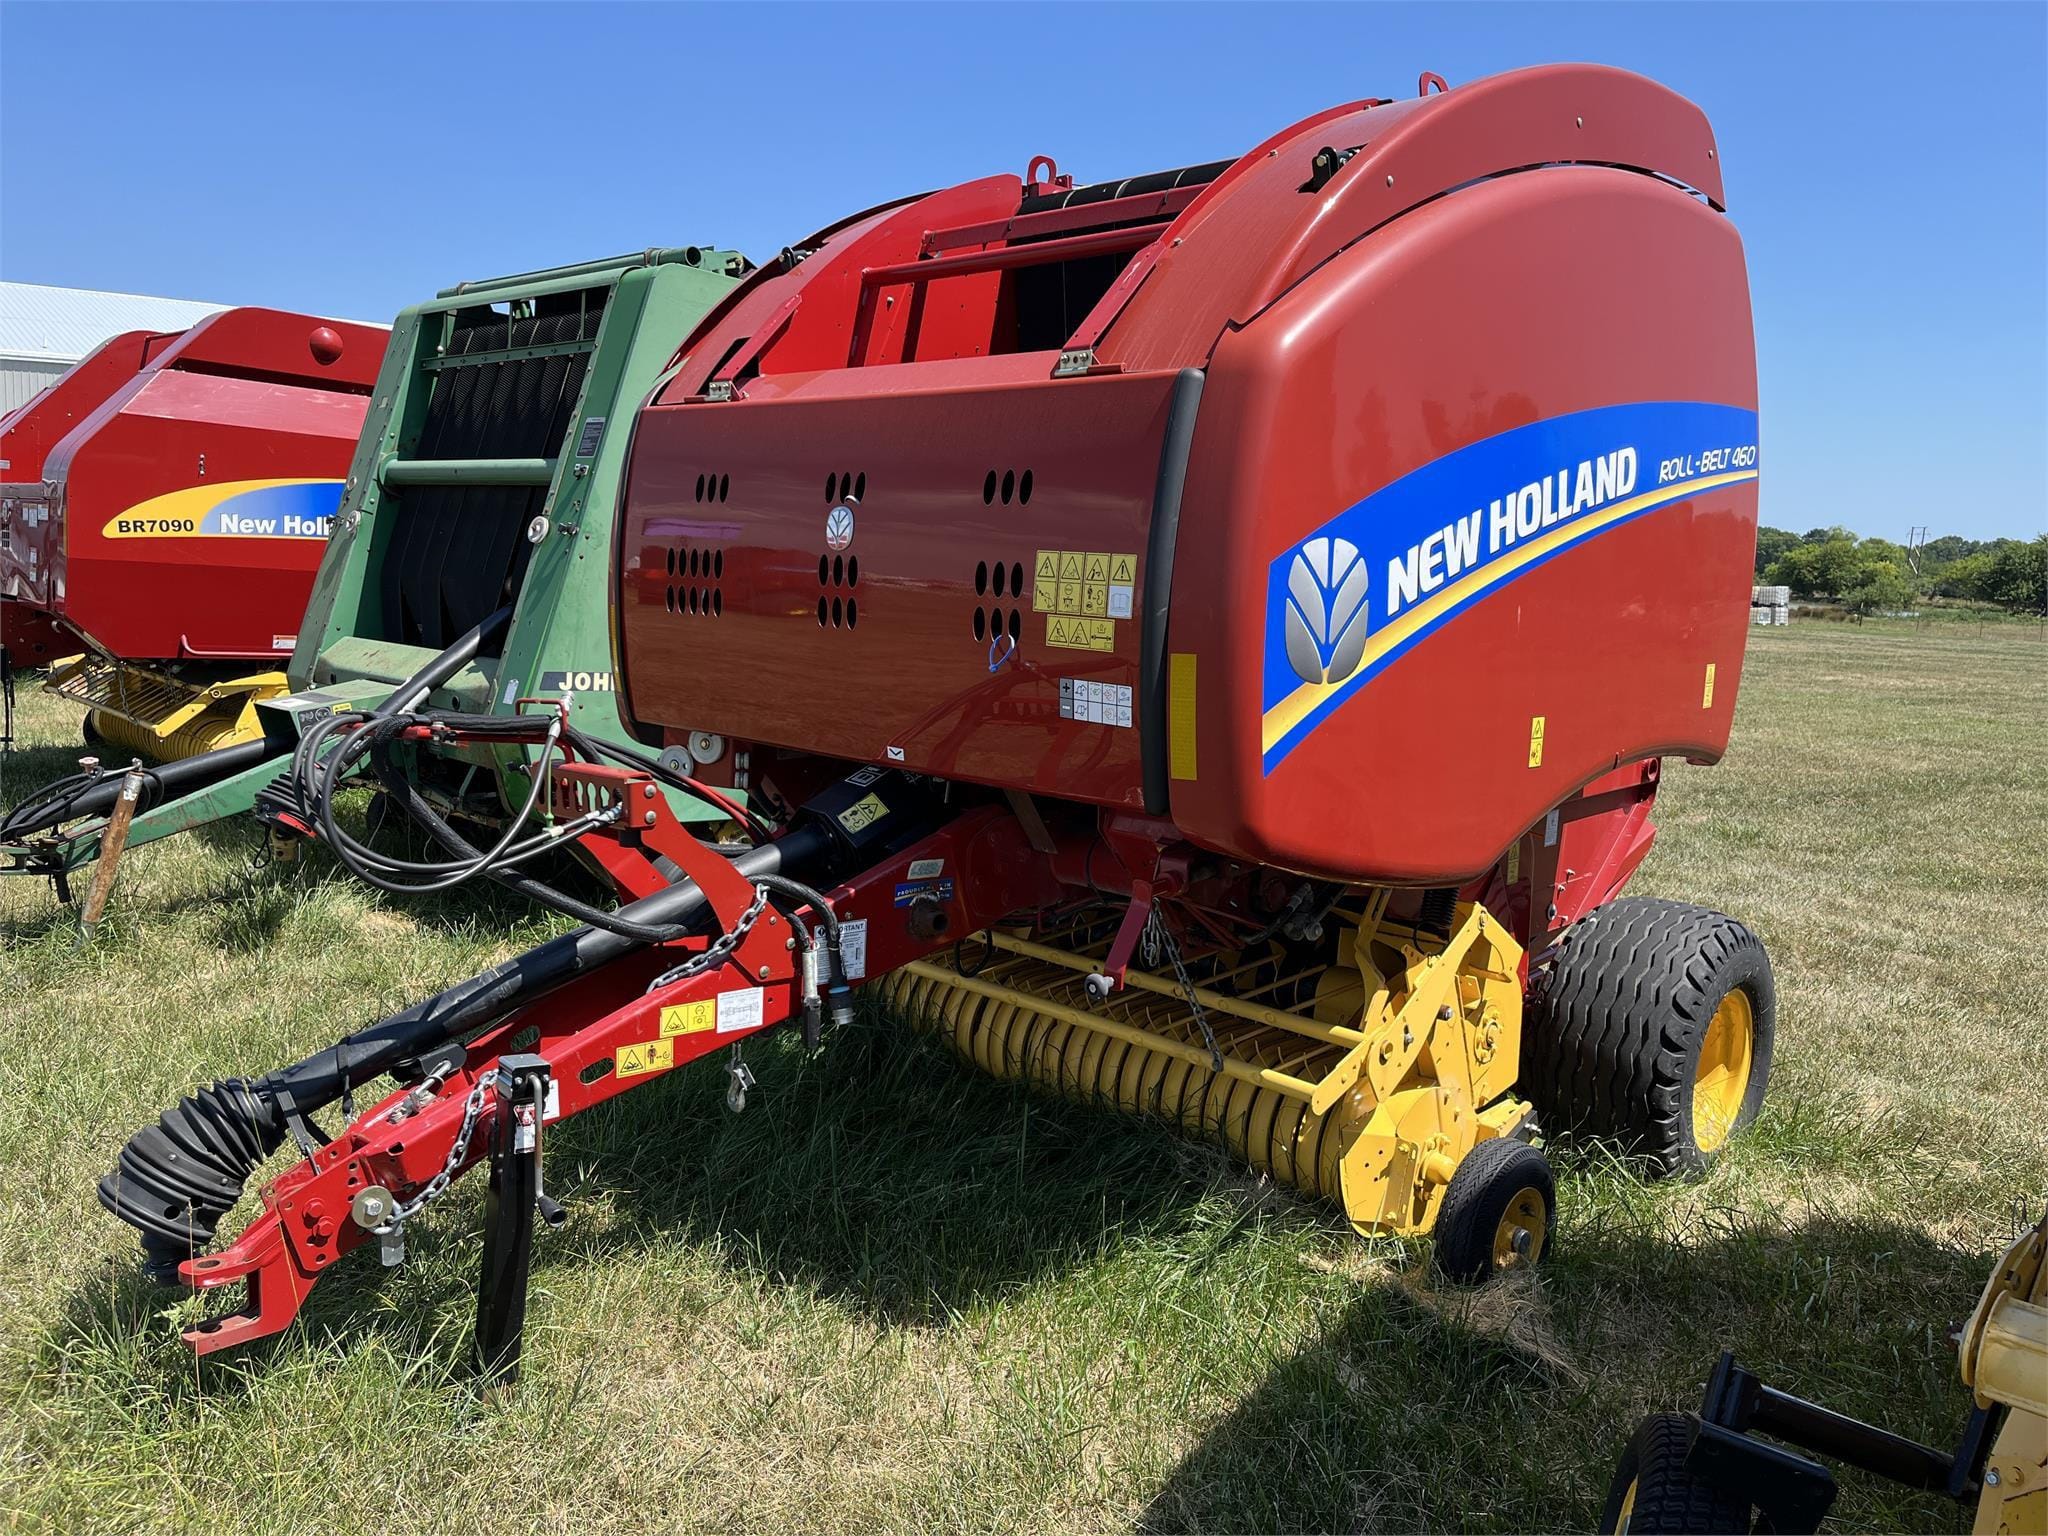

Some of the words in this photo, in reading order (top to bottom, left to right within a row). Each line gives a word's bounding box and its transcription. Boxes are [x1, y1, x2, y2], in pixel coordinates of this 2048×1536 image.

[1659, 448, 1732, 484] ROLL-BELT
[1732, 445, 1756, 468] 460
[118, 519, 194, 533] BR7090
[220, 513, 277, 534] New
[283, 514, 333, 536] Holl
[1387, 508, 1482, 616] NEW
[1489, 446, 1637, 554] HOLLAND
[558, 672, 614, 691] JOH
[839, 923, 864, 932] ORTANT
